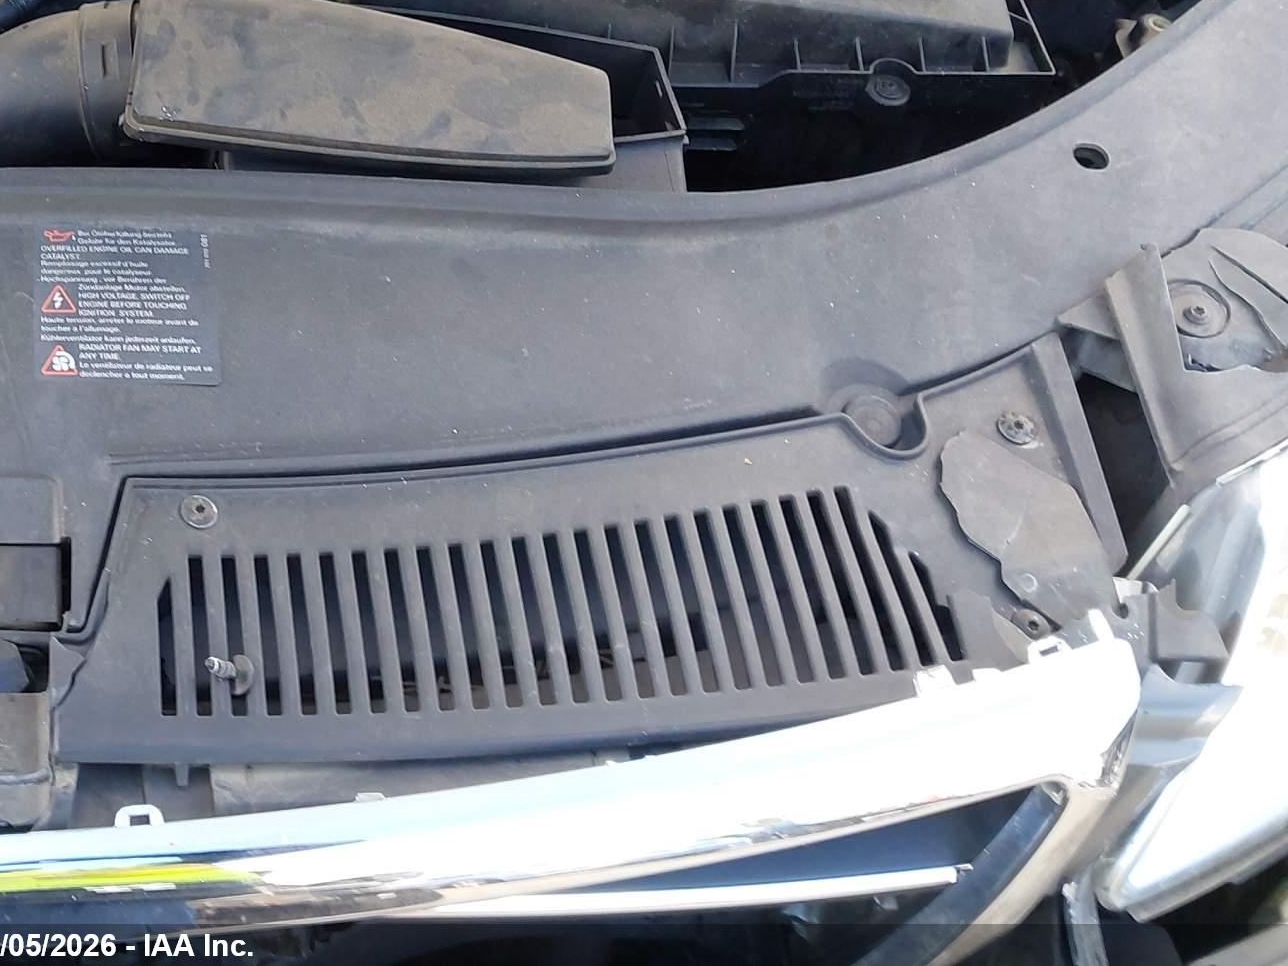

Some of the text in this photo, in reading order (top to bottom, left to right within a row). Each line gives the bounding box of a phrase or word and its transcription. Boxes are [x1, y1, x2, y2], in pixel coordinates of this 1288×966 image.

[40, 245, 87, 253] OVERFILLED
[153, 247, 188, 255] DAMAGE
[78, 292, 100, 300] HIGH
[140, 293, 173, 301] SWITCH
[110, 301, 142, 309] BEFORE
[144, 302, 187, 310] TOUCHING
[78, 309, 115, 317] IGNITION
[79, 344, 121, 352] RADIATOR
[123, 344, 141, 352] FAN
[162, 345, 188, 353] START
[79, 352, 98, 360] ANY
